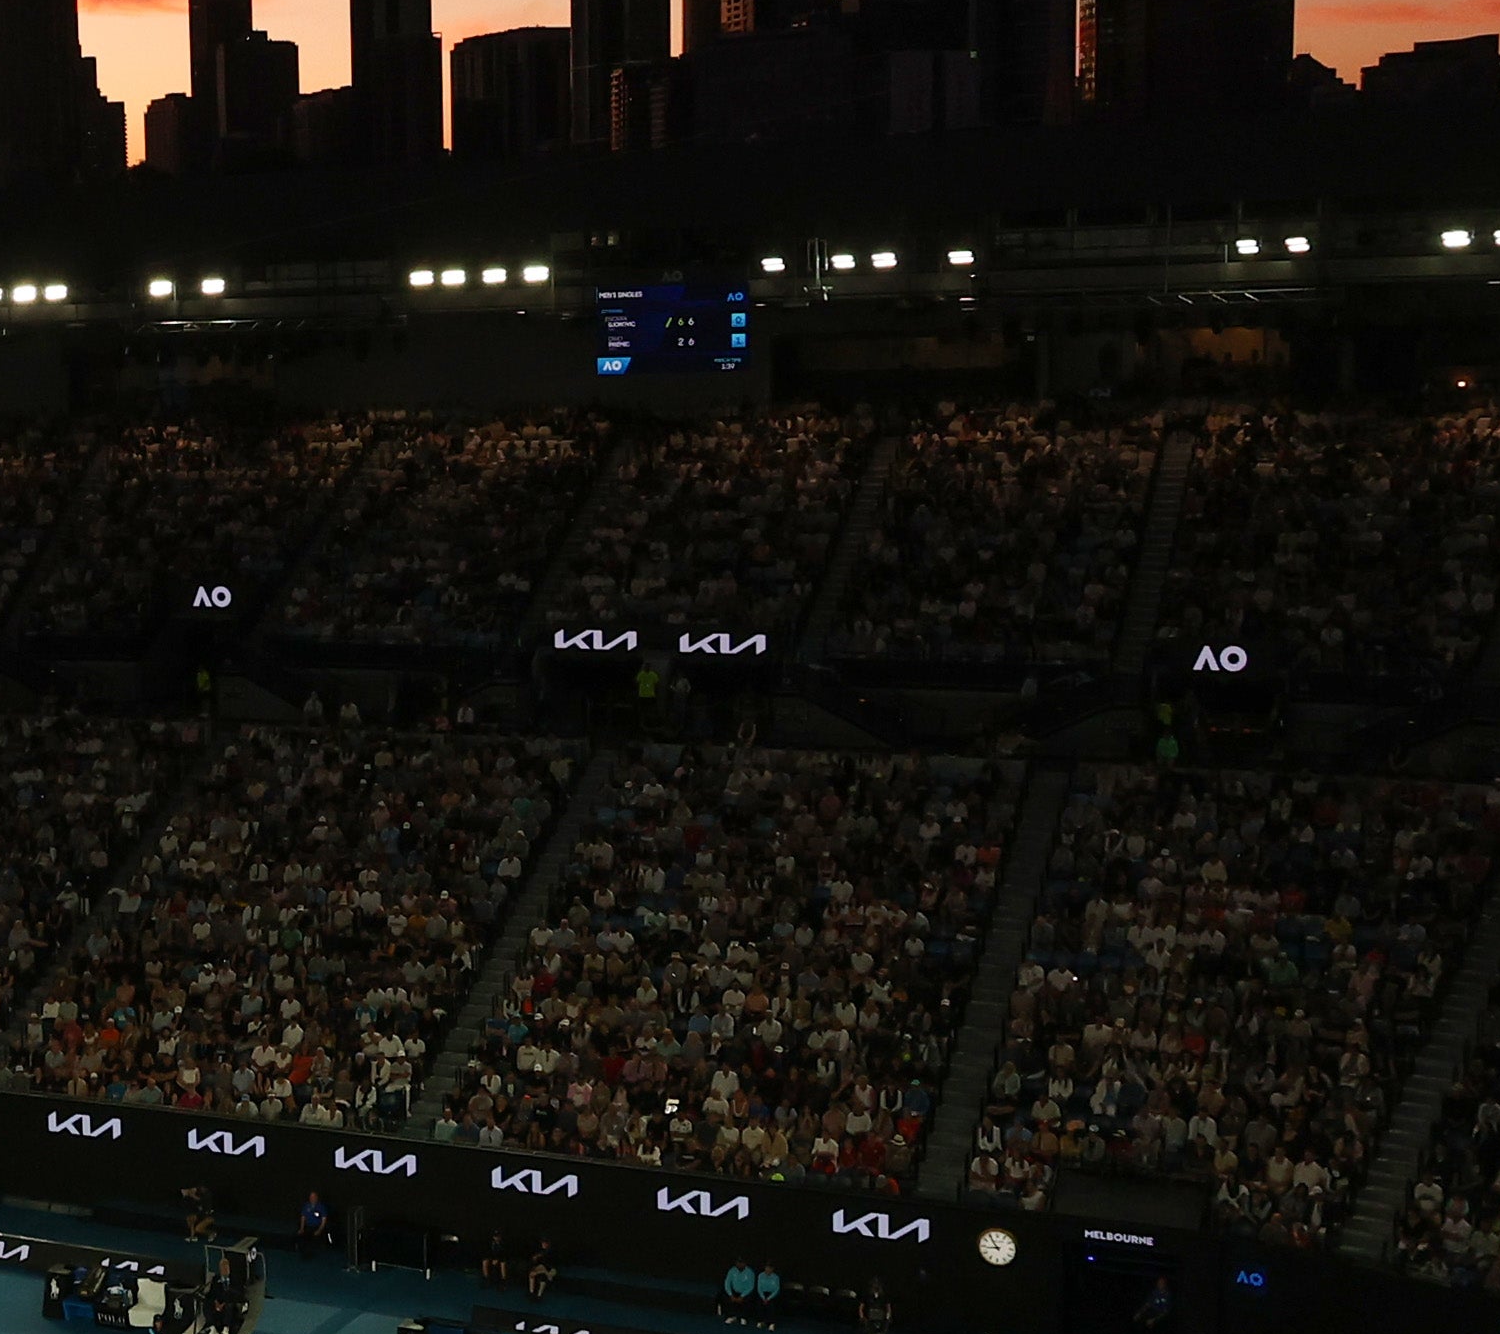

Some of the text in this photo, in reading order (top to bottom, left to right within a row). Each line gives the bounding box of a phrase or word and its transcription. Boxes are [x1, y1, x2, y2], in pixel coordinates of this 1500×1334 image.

[728, 292, 744, 301] AO
[688, 317, 695, 326] 6
[602, 360, 623, 372] AO
[193, 586, 231, 607] AO
[555, 629, 637, 650] KIA
[680, 633, 766, 654] KIA
[1193, 646, 1247, 671] AO
[48, 1112, 121, 1139] KIA
[188, 1129, 264, 1157] KIA
[335, 1147, 416, 1176] KIA
[492, 1166, 577, 1197] KIA
[658, 1187, 748, 1219] KIA
[833, 1210, 929, 1242] KIA
[1085, 1230, 1153, 1245] MELBOURNE
[1236, 1270, 1264, 1287] AO
